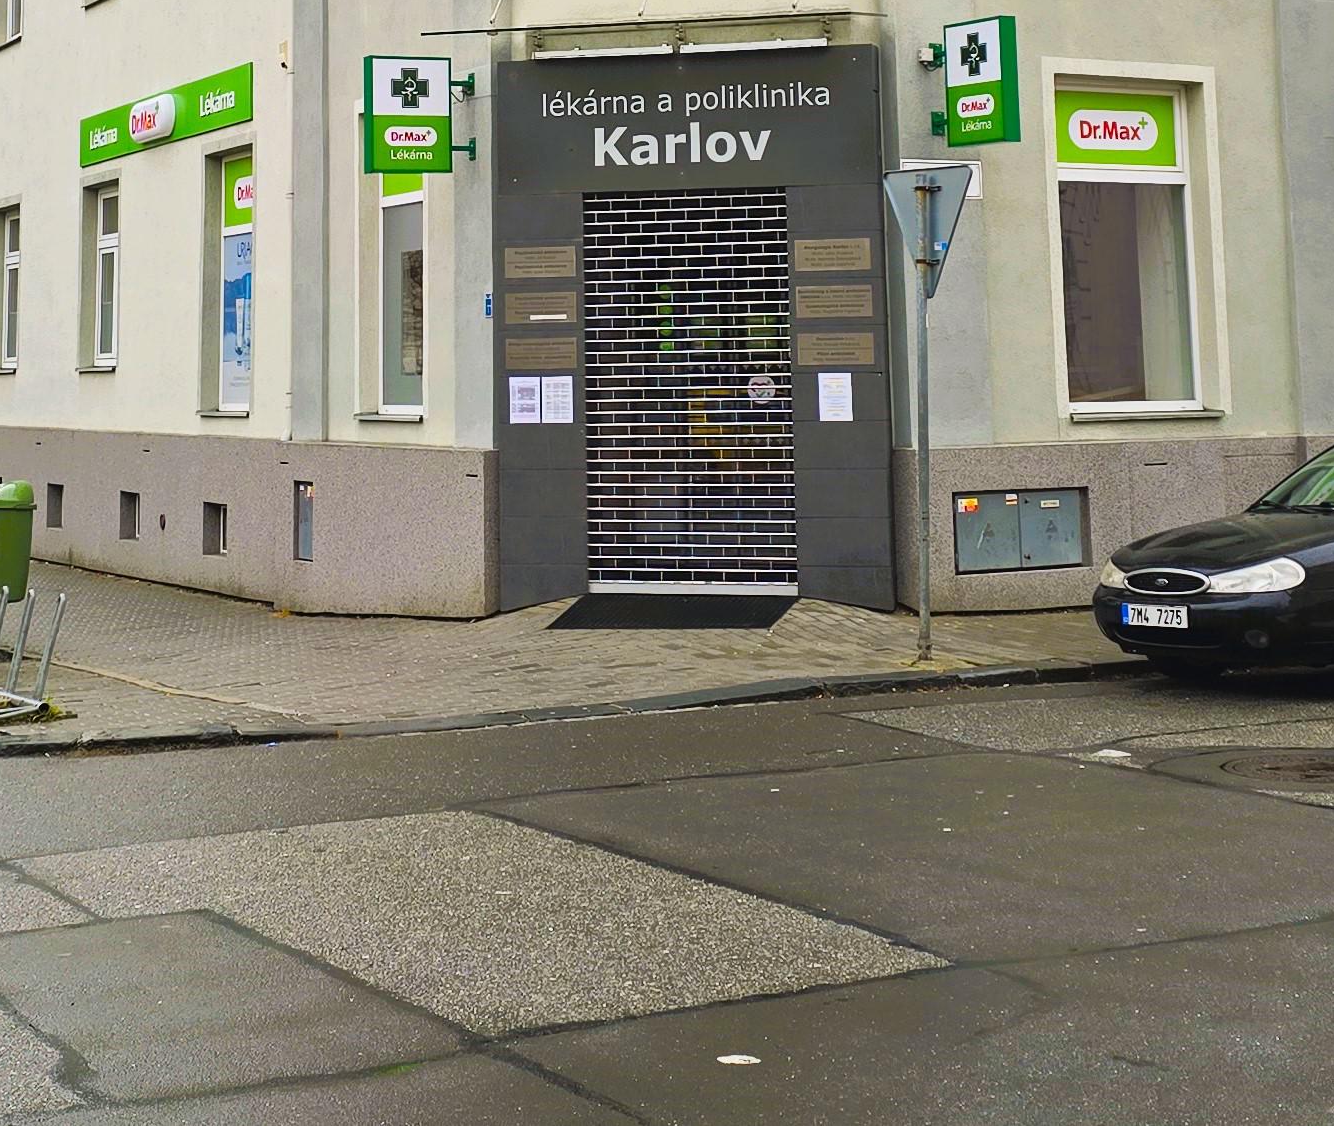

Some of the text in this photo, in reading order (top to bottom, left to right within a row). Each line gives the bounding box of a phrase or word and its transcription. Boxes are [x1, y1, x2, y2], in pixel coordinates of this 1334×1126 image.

[542, 81, 831, 117] lékárna a poliklinika
[961, 100, 988, 113] Dr.Max
[90, 88, 235, 150] Lékárna Dr.Max Lékárna
[961, 119, 993, 133] Lékárna
[391, 131, 427, 142] Dr.Max
[1079, 120, 1141, 141] Dr.Max
[594, 122, 771, 167] Karlov
[390, 149, 433, 160] Lékárna
[1131, 608, 1182, 625] 7M4 7275
